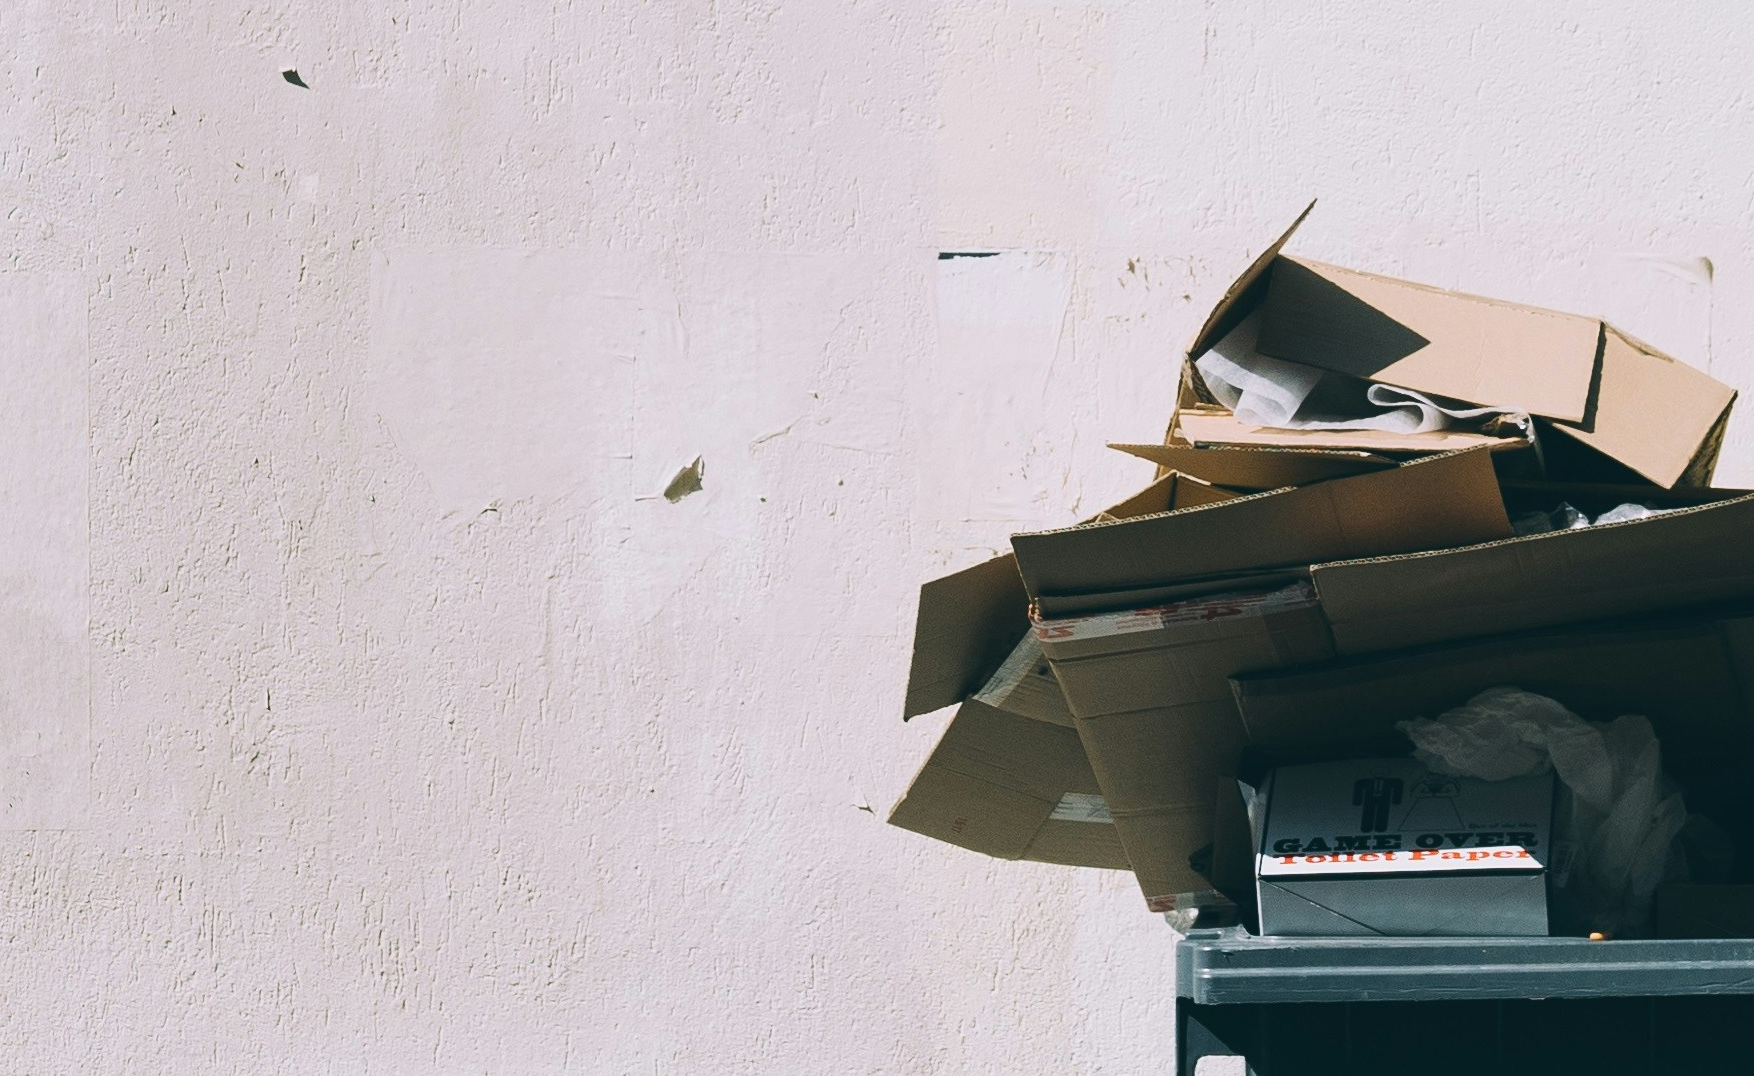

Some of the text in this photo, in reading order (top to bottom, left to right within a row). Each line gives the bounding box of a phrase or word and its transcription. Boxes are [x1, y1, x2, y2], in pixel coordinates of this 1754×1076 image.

[1273, 831, 1539, 853] GAME OVER
[1273, 848, 1537, 865] Toilet Paper
